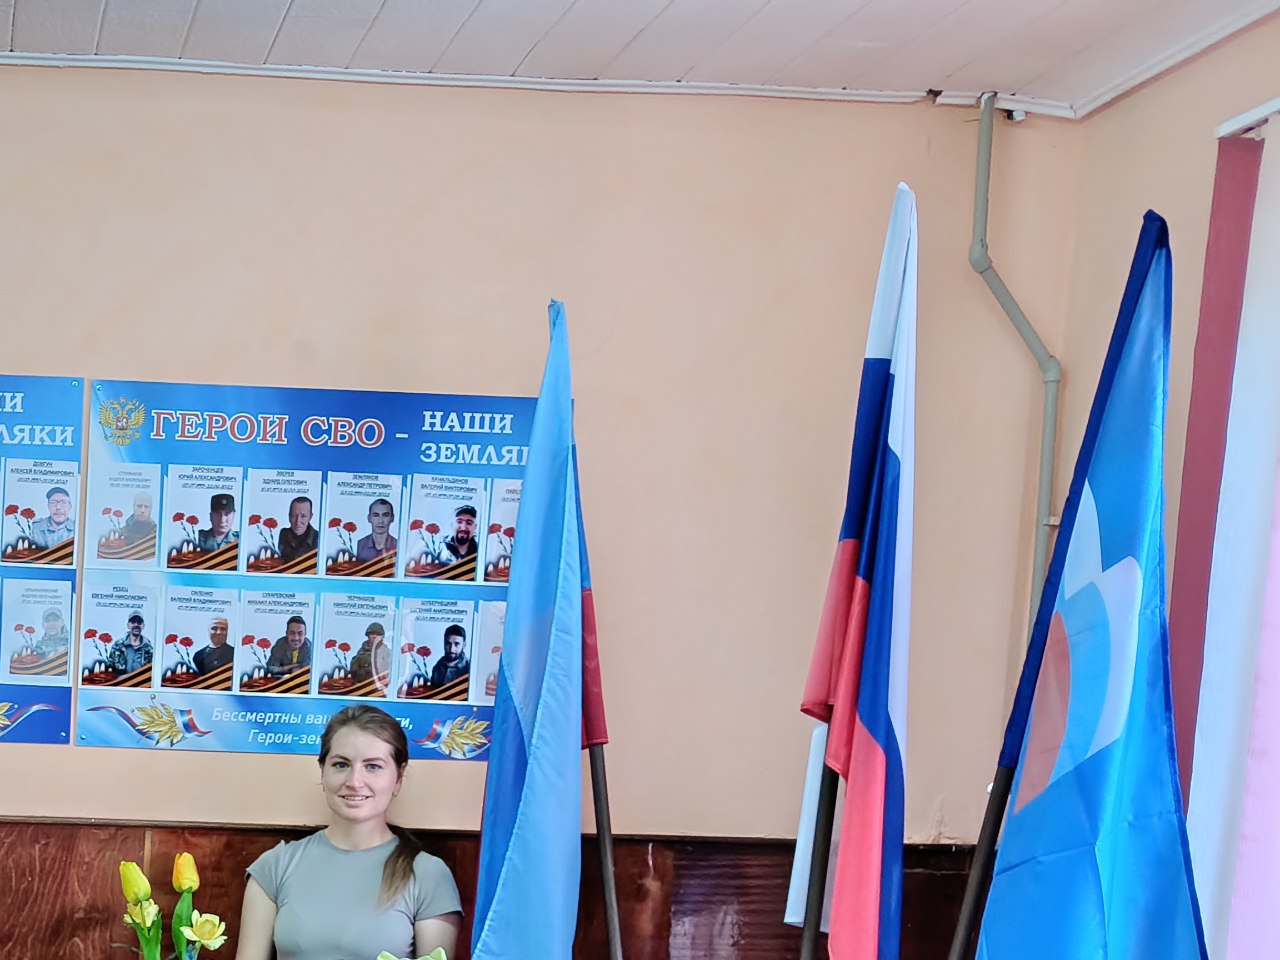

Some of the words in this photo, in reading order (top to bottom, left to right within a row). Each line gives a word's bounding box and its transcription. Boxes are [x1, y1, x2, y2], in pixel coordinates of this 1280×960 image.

[151, 409, 288, 444] ГЕРОИ
[300, 416, 385, 448] СВО
[422, 411, 513, 435] НАШИ
[421, 442, 528, 466] ЗЕМЛЯ
[211, 707, 302, 725] Бессмертны
[305, 714, 332, 725] ва
[248, 729, 321, 747] Герои-зе
